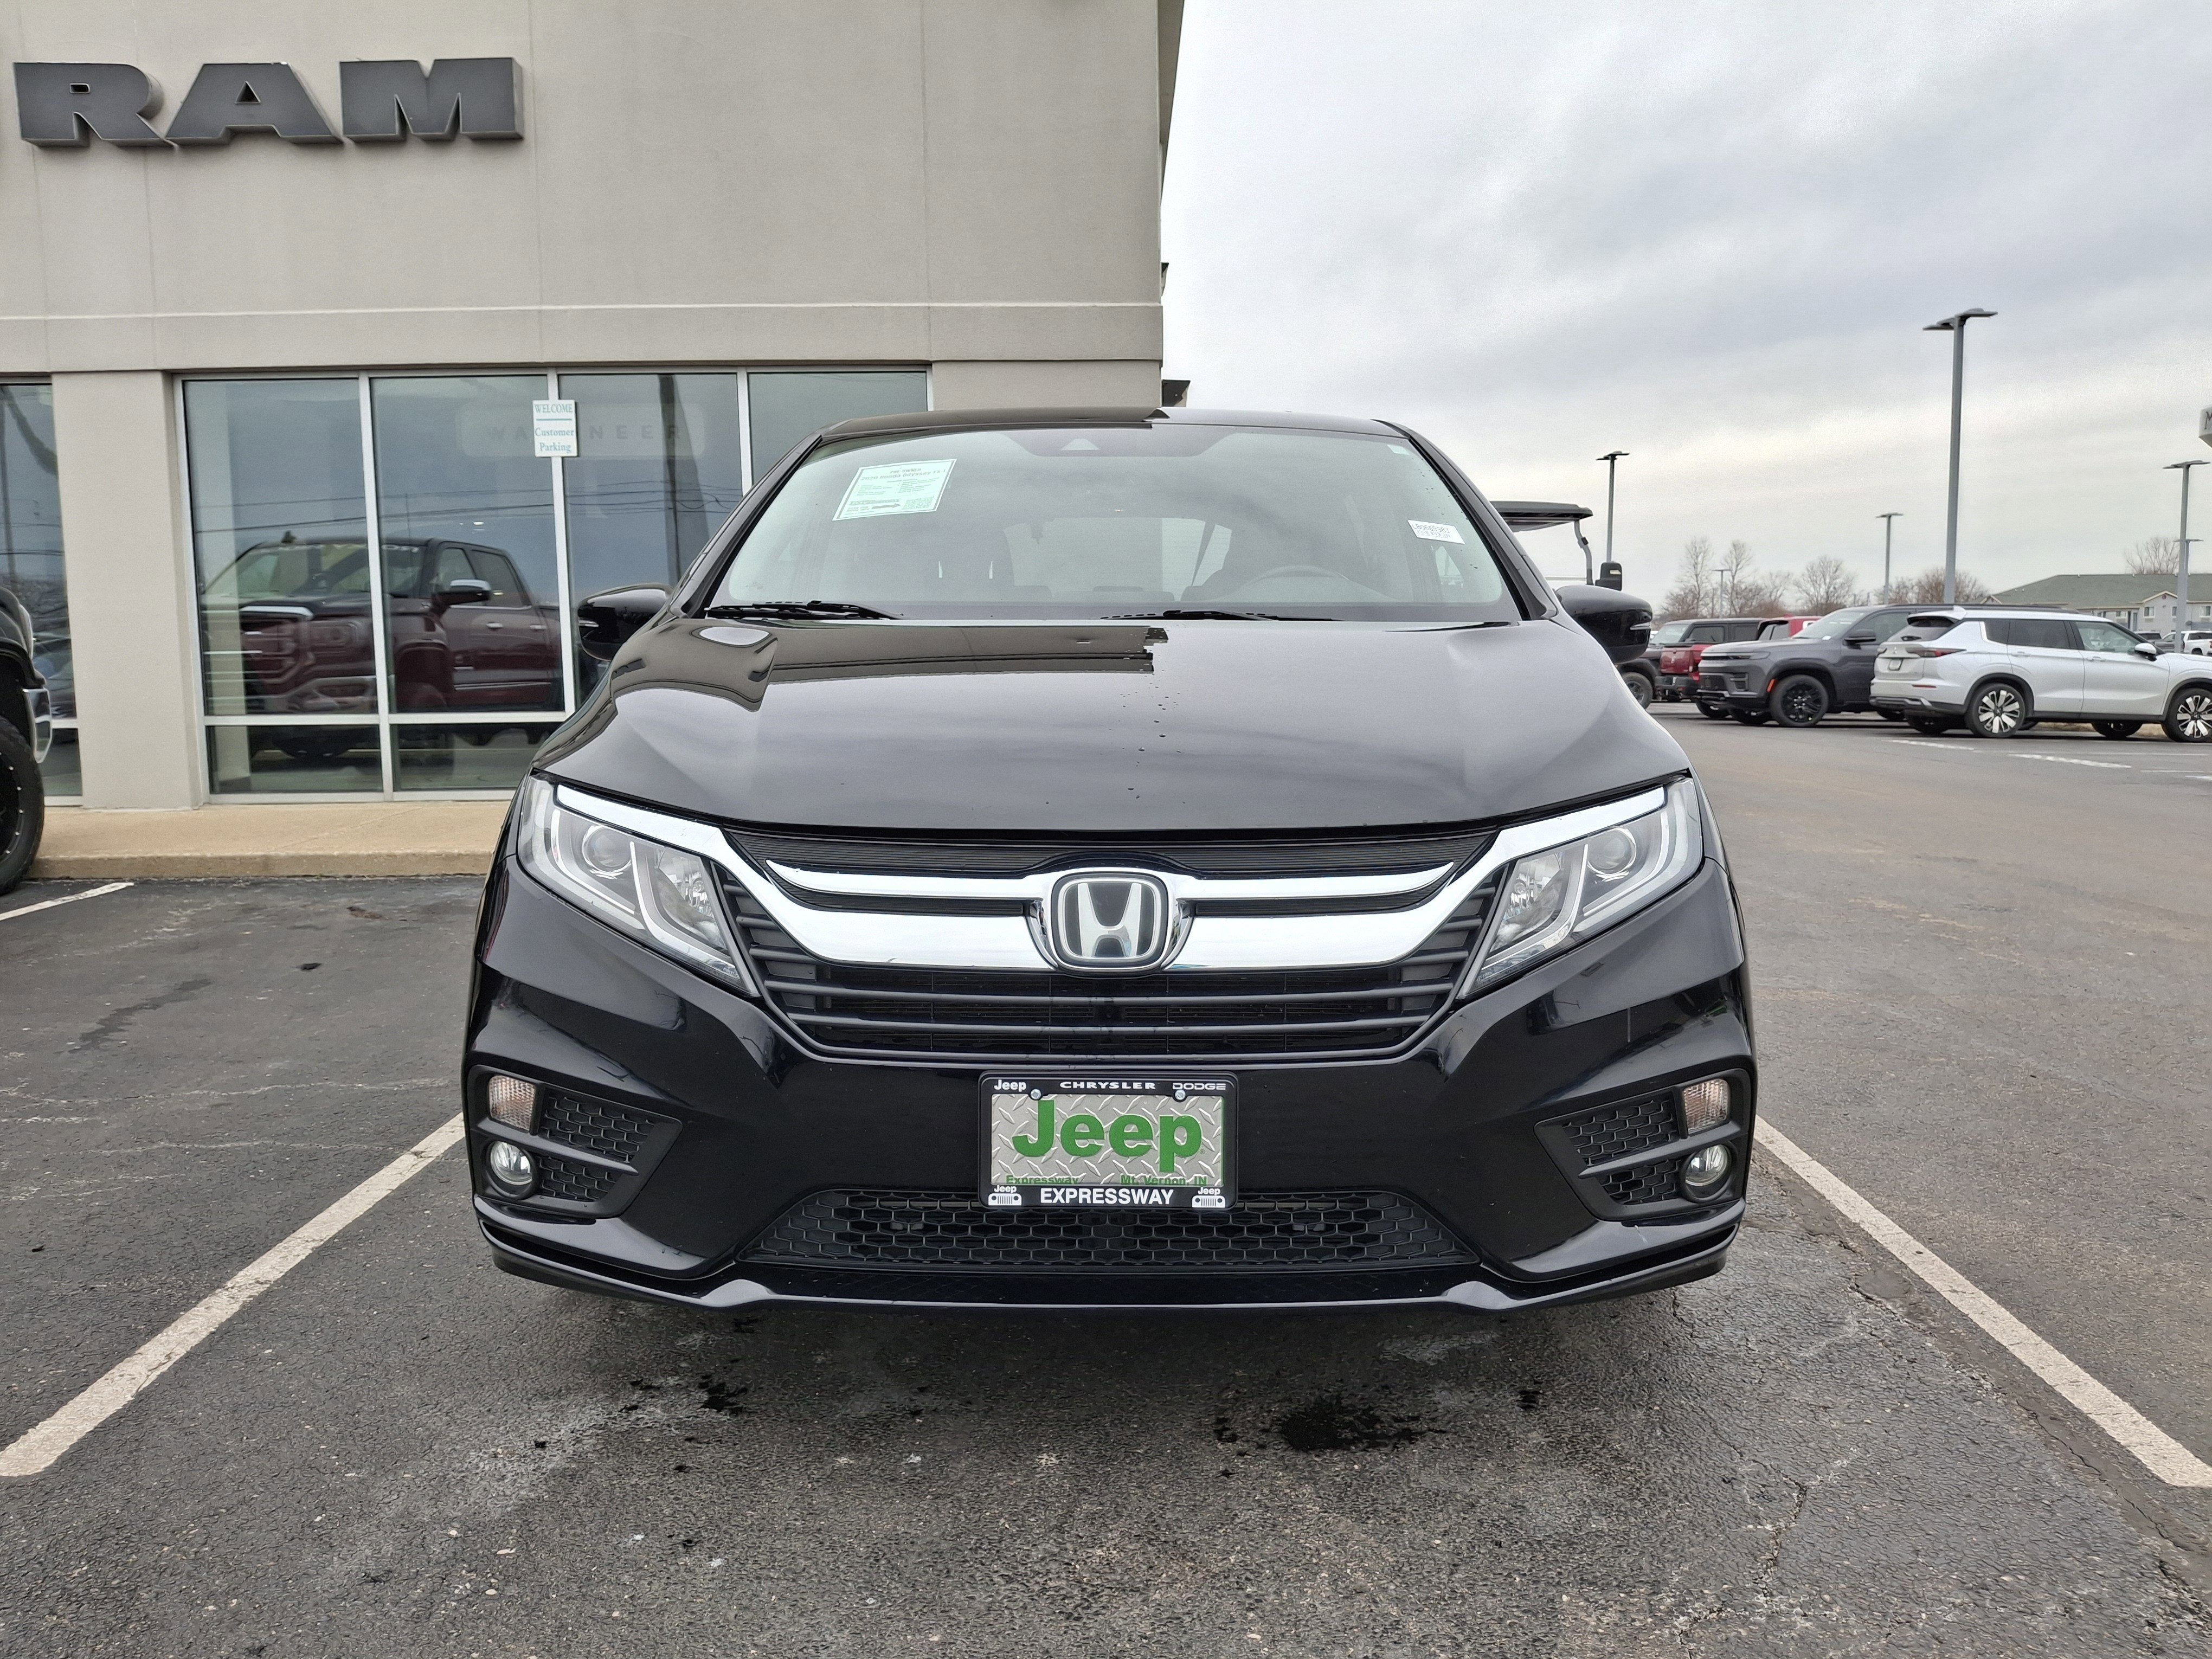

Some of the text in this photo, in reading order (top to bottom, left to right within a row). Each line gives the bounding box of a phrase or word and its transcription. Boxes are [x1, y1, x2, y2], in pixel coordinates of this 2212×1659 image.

[14, 57, 523, 147] RAM
[534, 403, 573, 413] WELCOME
[487, 425, 680, 440] WANEER
[535, 427, 574, 436] Customer
[539, 442, 572, 454] Parking
[993, 1079, 1027, 1092] Jeep
[1059, 1081, 1156, 1090] CHRYSLER
[1172, 1082, 1226, 1090] DODGE
[1012, 1099, 1203, 1173] Jeep
[1006, 1174, 1079, 1185] Expressway
[1120, 1174, 1140, 1185] Mt.
[1194, 1176, 1207, 1186] IN
[994, 1185, 1017, 1193] Jeep
[1197, 1187, 1221, 1195] Jeep
[1040, 1187, 1174, 1205] EXPRESSWAY
